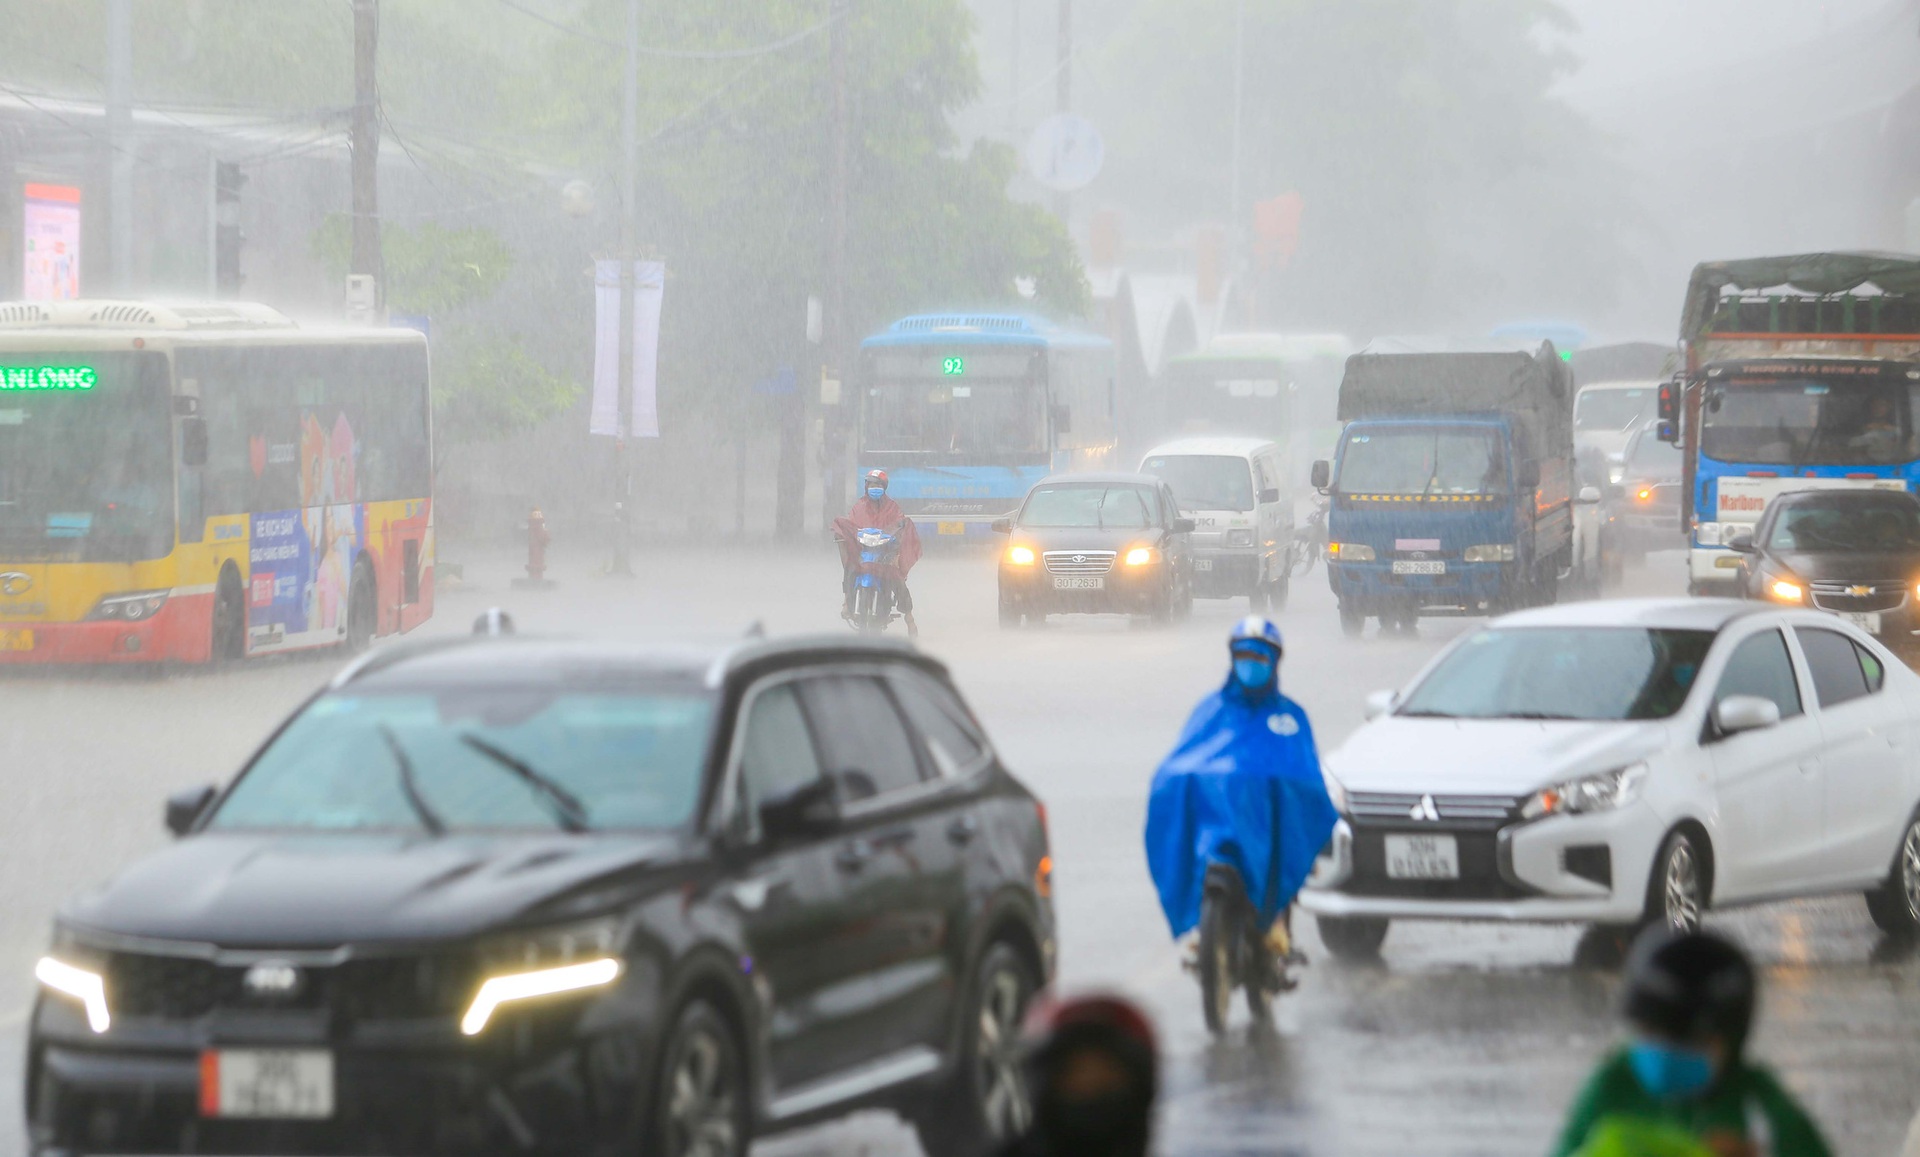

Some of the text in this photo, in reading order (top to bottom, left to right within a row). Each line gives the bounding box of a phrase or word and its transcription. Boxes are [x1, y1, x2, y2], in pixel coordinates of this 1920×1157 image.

[943, 357, 964, 375] 92
[1720, 494, 1765, 511] Marlboro
[1194, 517, 1216, 527] UKI
